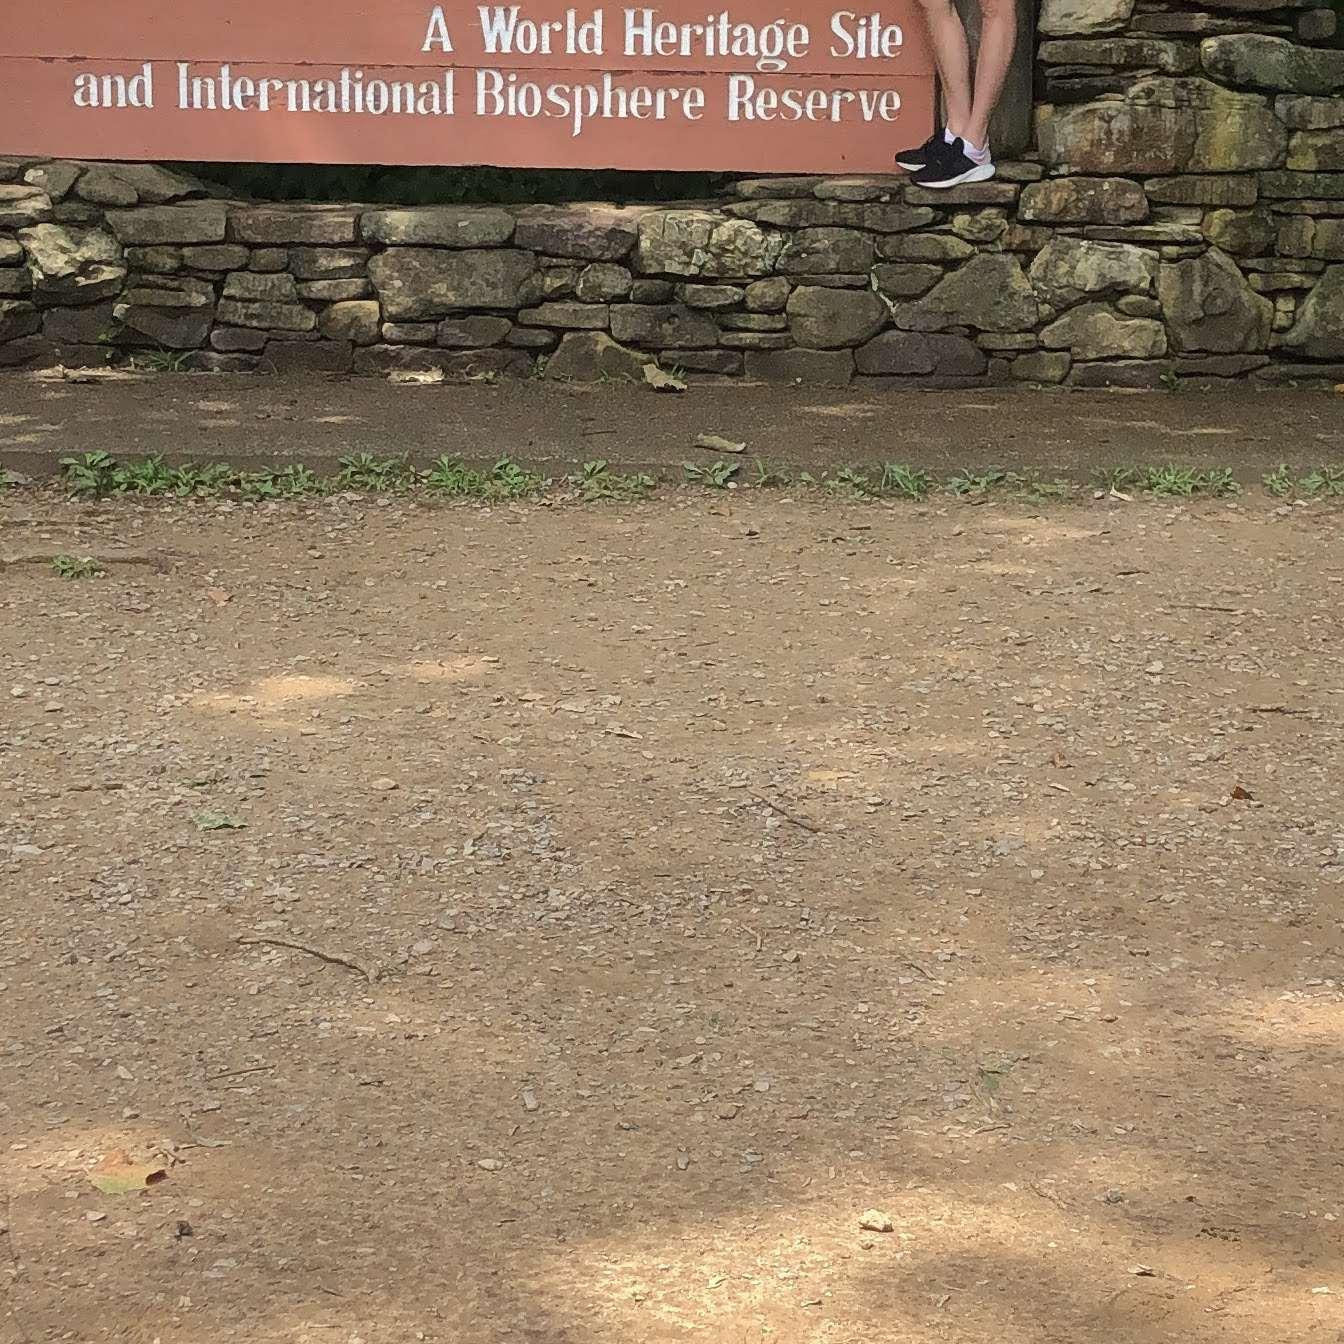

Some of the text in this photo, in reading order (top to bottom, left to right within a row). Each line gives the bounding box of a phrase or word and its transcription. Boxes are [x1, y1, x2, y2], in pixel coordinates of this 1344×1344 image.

[420, 5, 904, 72] A World Heritage Site
[73, 62, 902, 137] and International Biosphere Reserve
